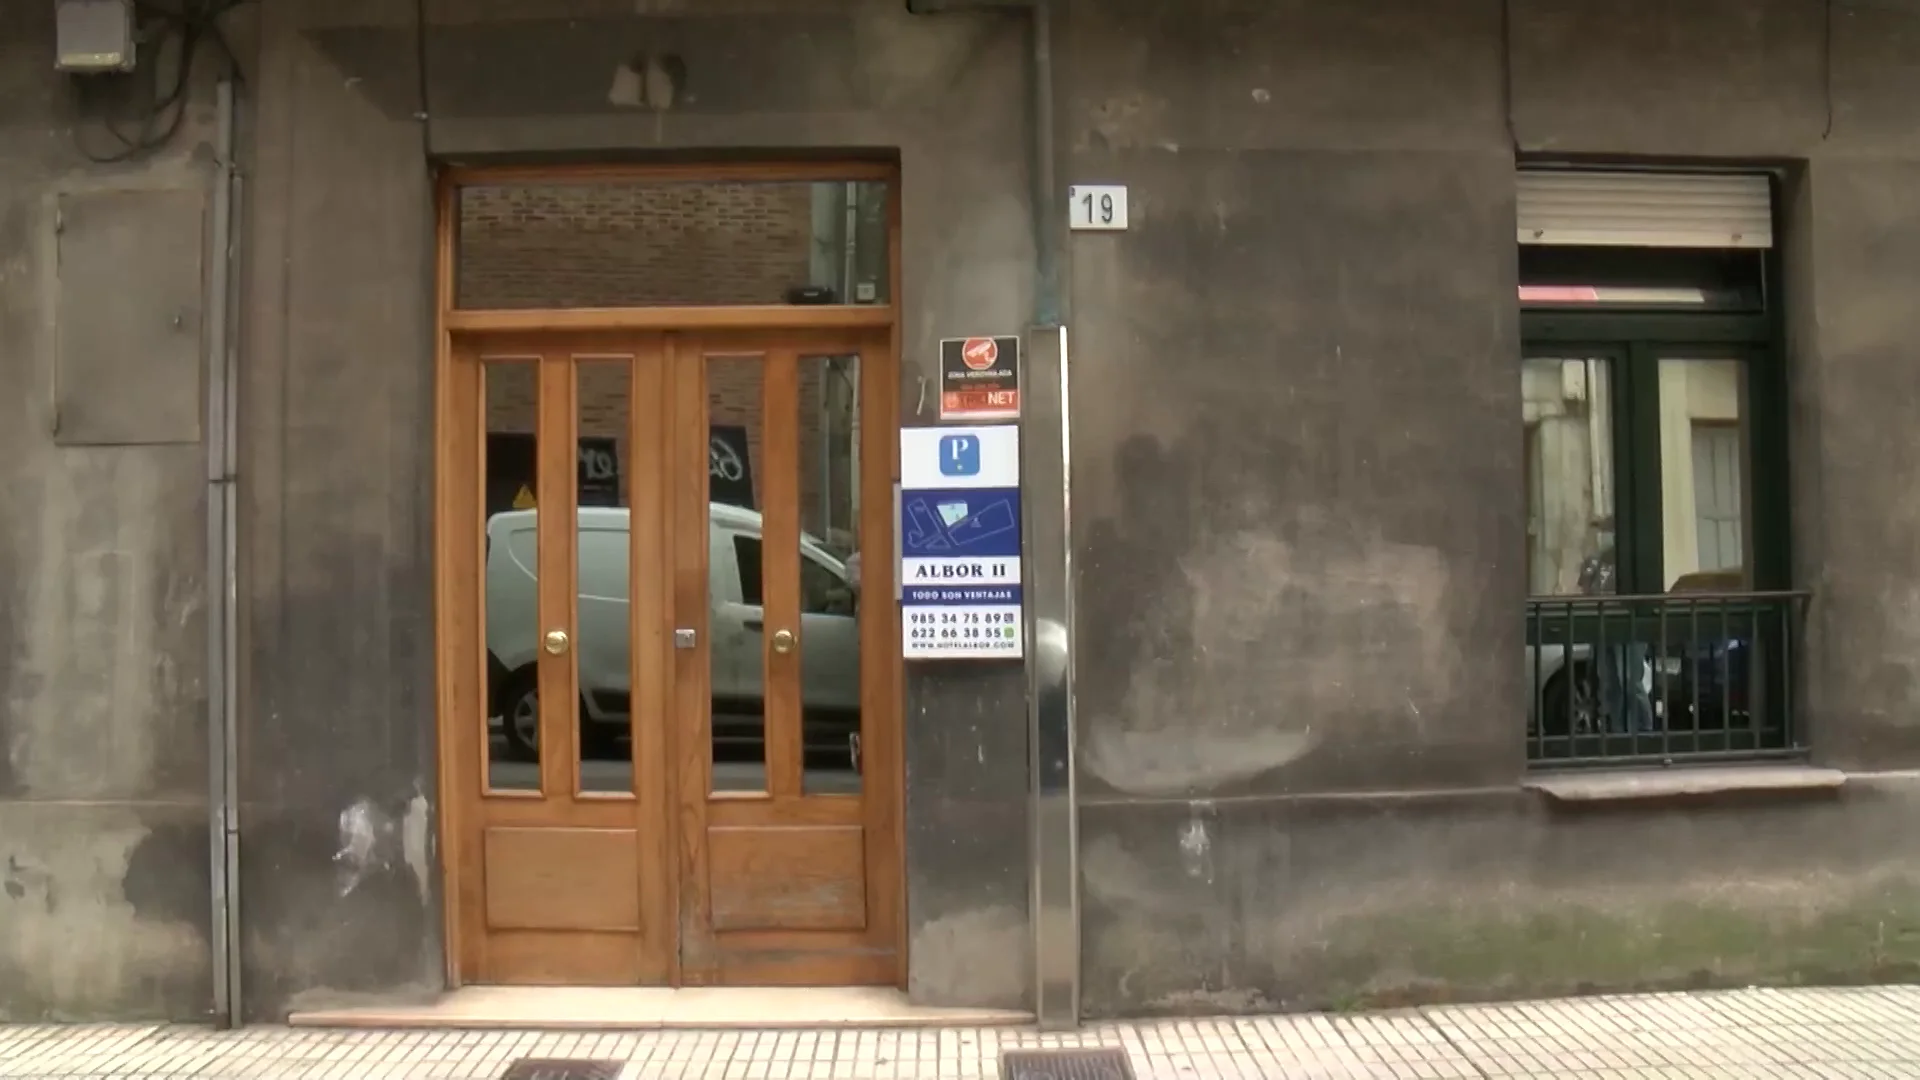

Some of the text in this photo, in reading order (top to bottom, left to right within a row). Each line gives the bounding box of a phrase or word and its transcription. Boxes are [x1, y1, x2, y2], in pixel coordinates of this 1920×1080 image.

[1082, 192, 1113, 224] 19
[951, 439, 969, 460] P
[915, 563, 1006, 578] ALBOR II
[912, 590, 1012, 600] TODO SON VENTAJAS
[911, 613, 1001, 624] 985 34 75 89
[911, 627, 1001, 638] 622 66 38 55
